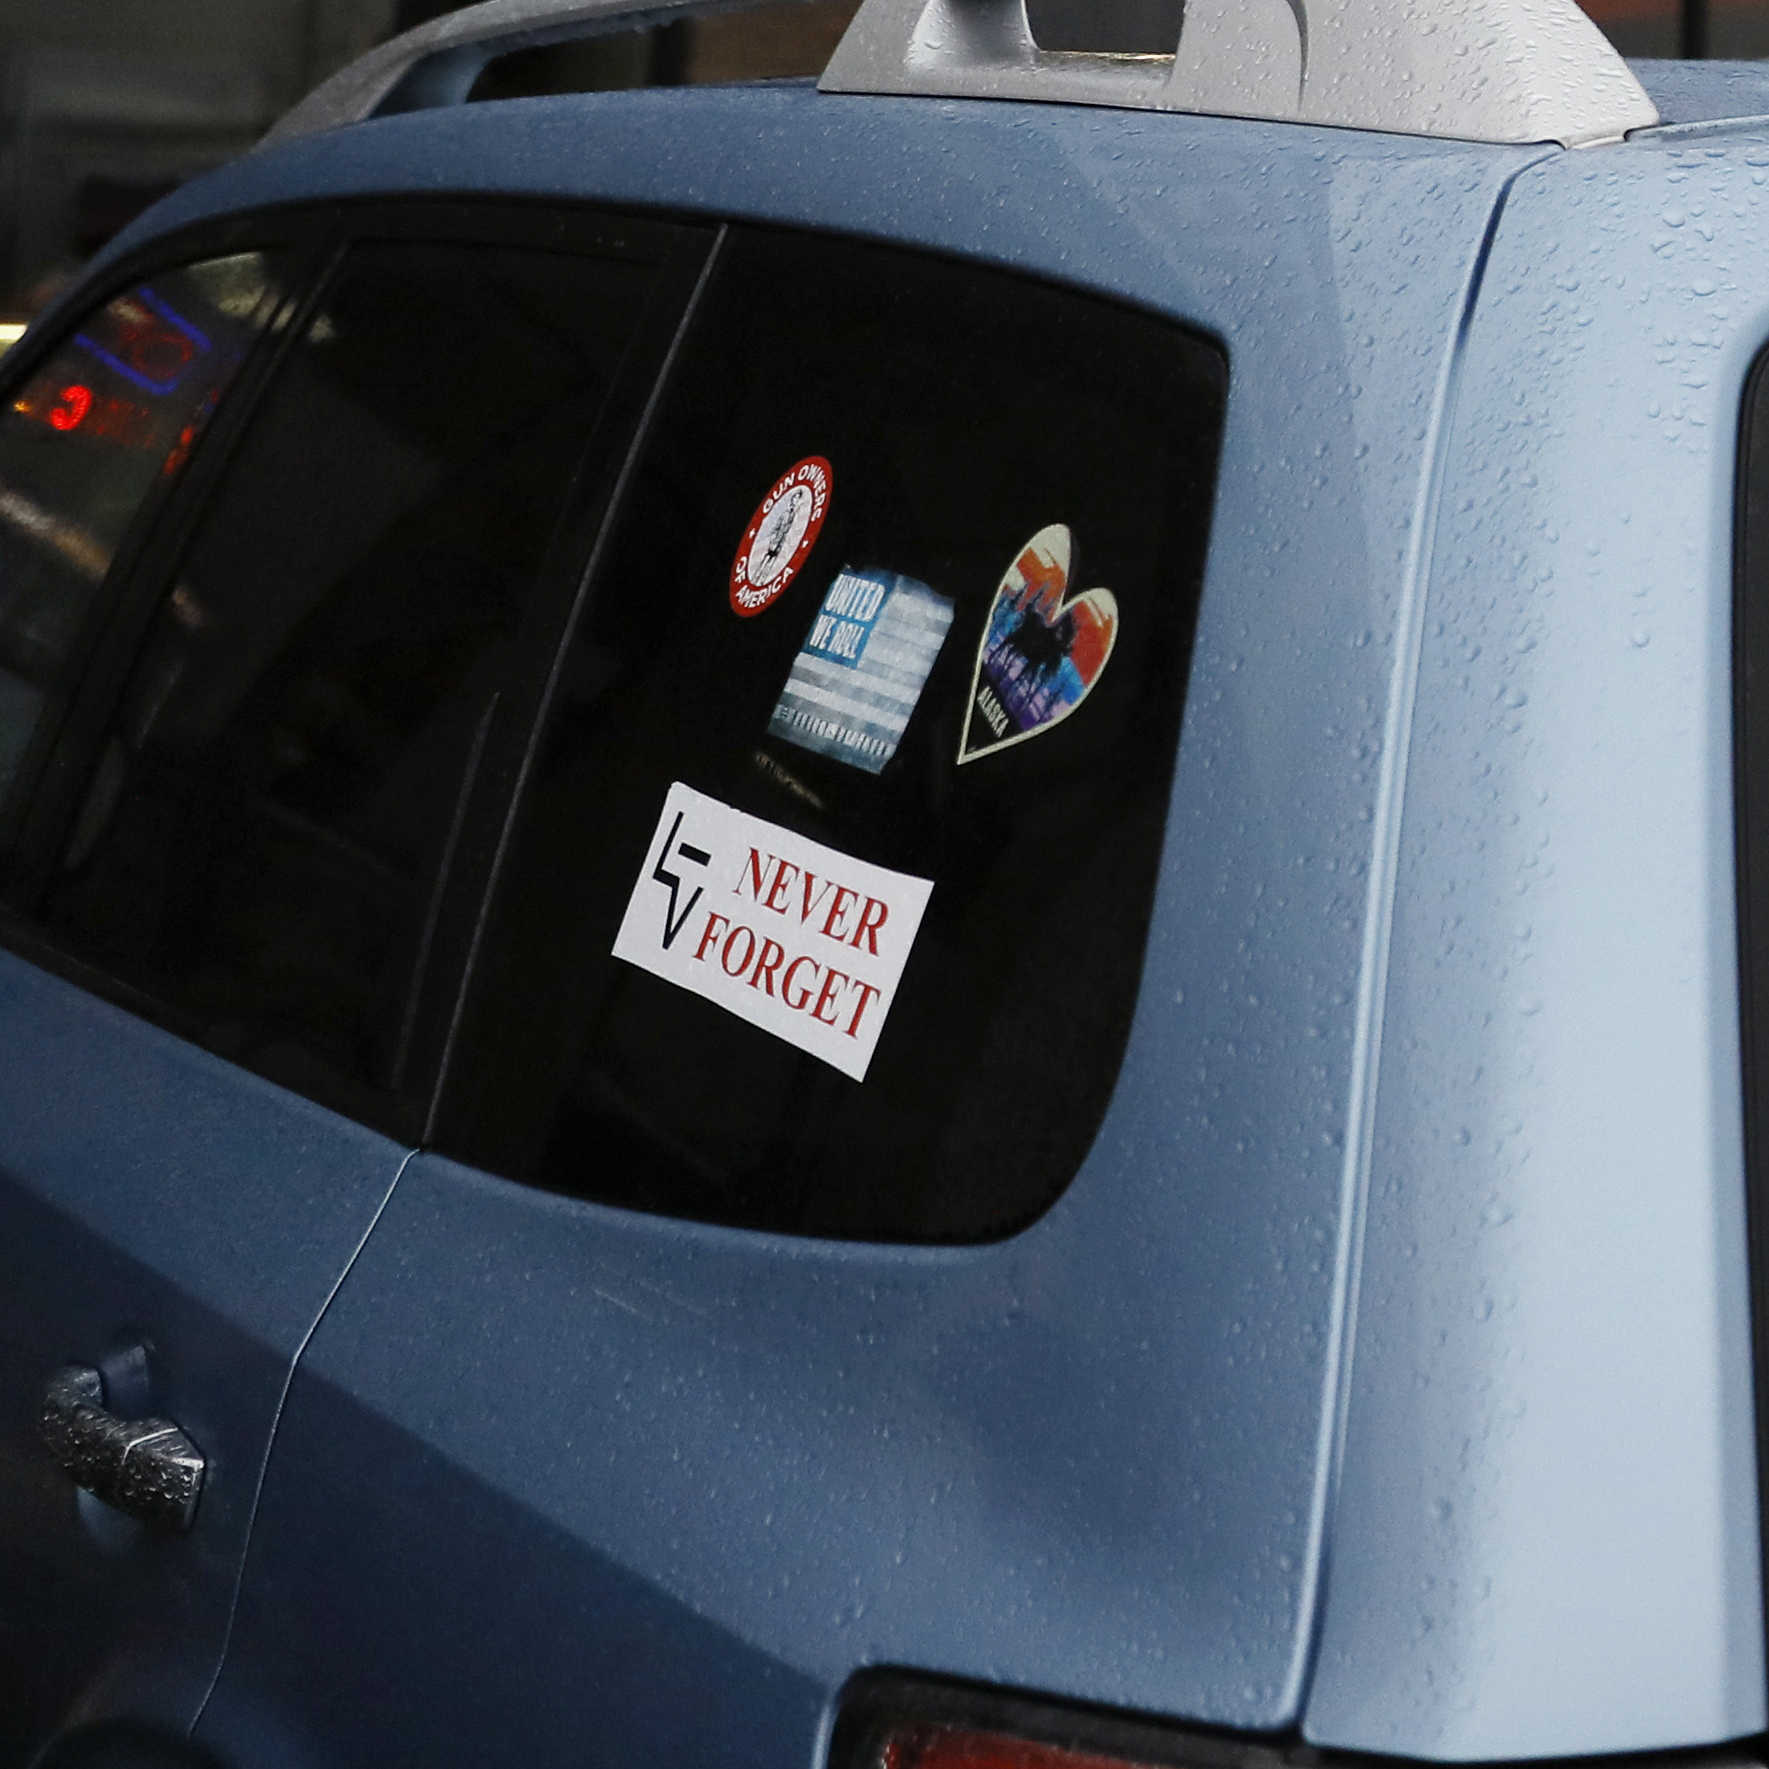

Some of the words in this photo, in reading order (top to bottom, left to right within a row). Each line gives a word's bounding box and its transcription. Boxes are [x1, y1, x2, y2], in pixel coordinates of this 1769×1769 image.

[762, 471, 796, 515] GUN
[797, 463, 827, 522] OWNERS
[735, 566, 795, 609] AMERICA
[824, 573, 885, 622] UNITED
[808, 614, 833, 651] WE
[976, 685, 1010, 738] ALASKA
[731, 845, 890, 959] NEVER
[692, 910, 882, 1040] FORGET
